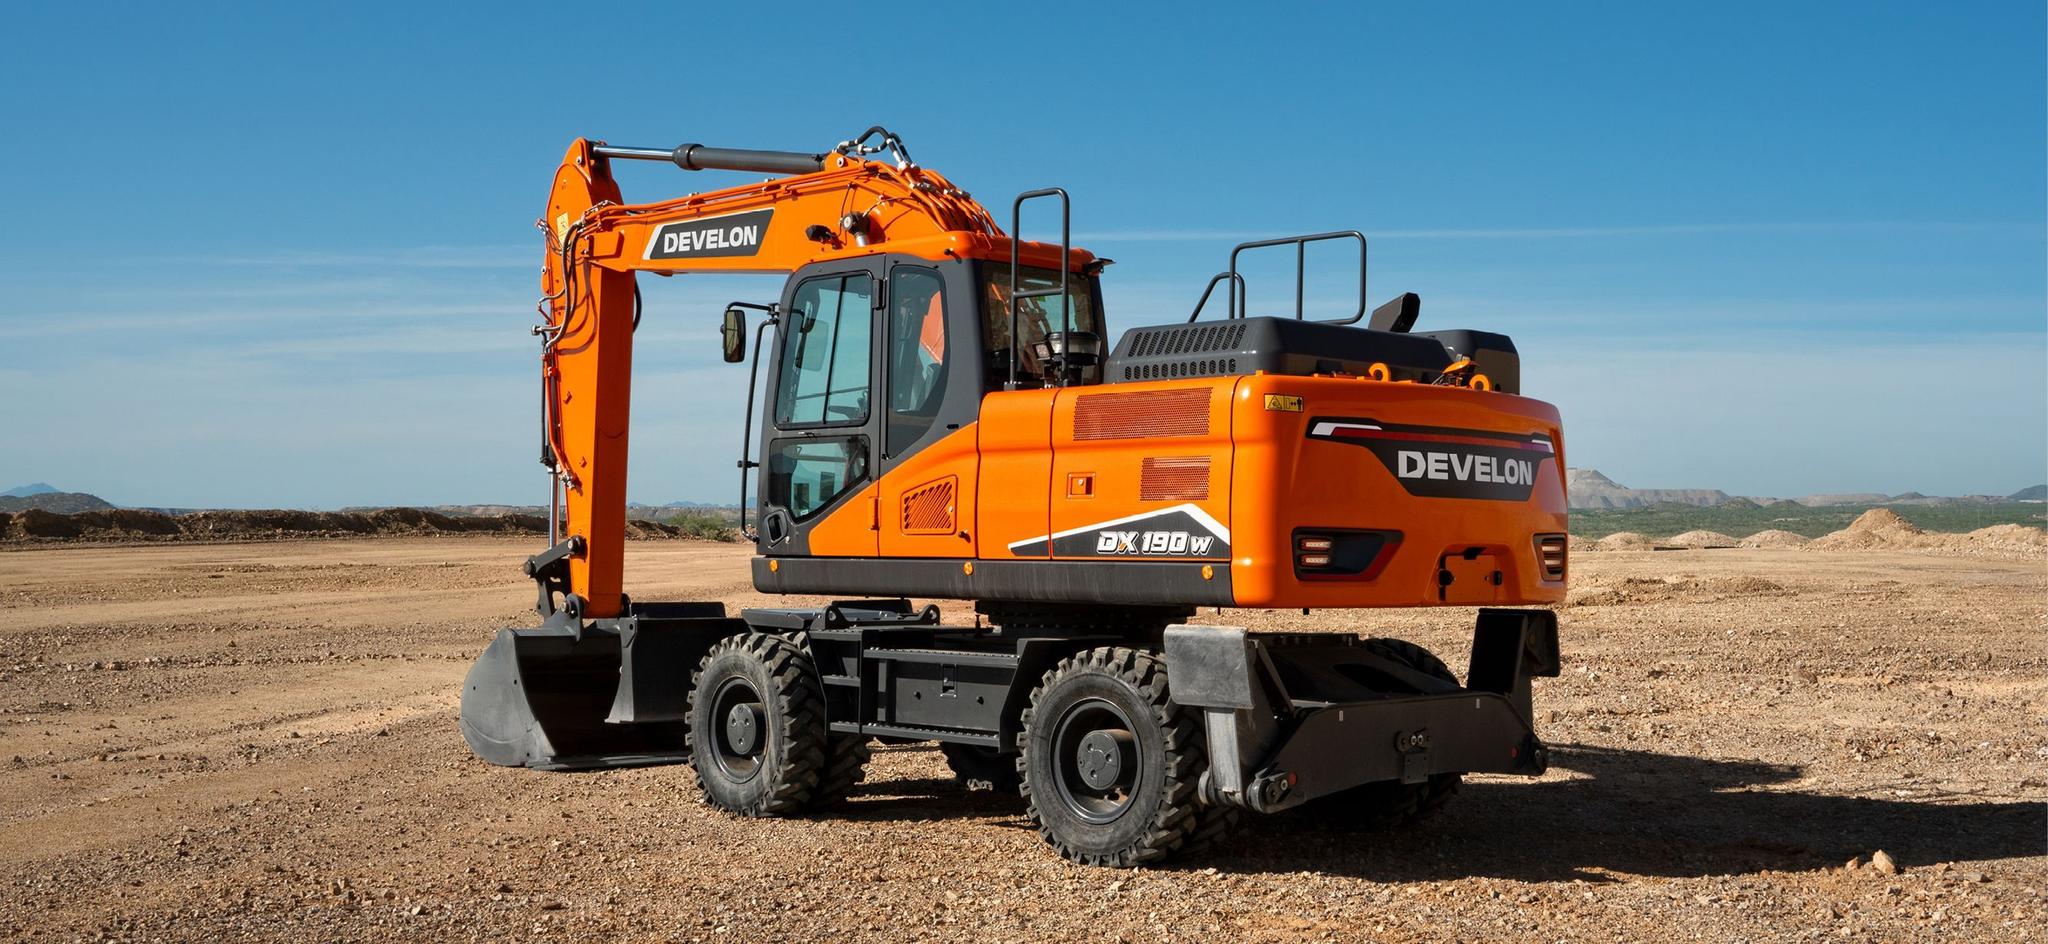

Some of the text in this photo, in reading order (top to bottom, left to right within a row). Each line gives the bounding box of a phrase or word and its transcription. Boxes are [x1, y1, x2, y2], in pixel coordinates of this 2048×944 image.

[663, 225, 758, 253] DEVELON
[1398, 450, 1533, 485] DEVELON
[1097, 531, 1139, 554] DX
